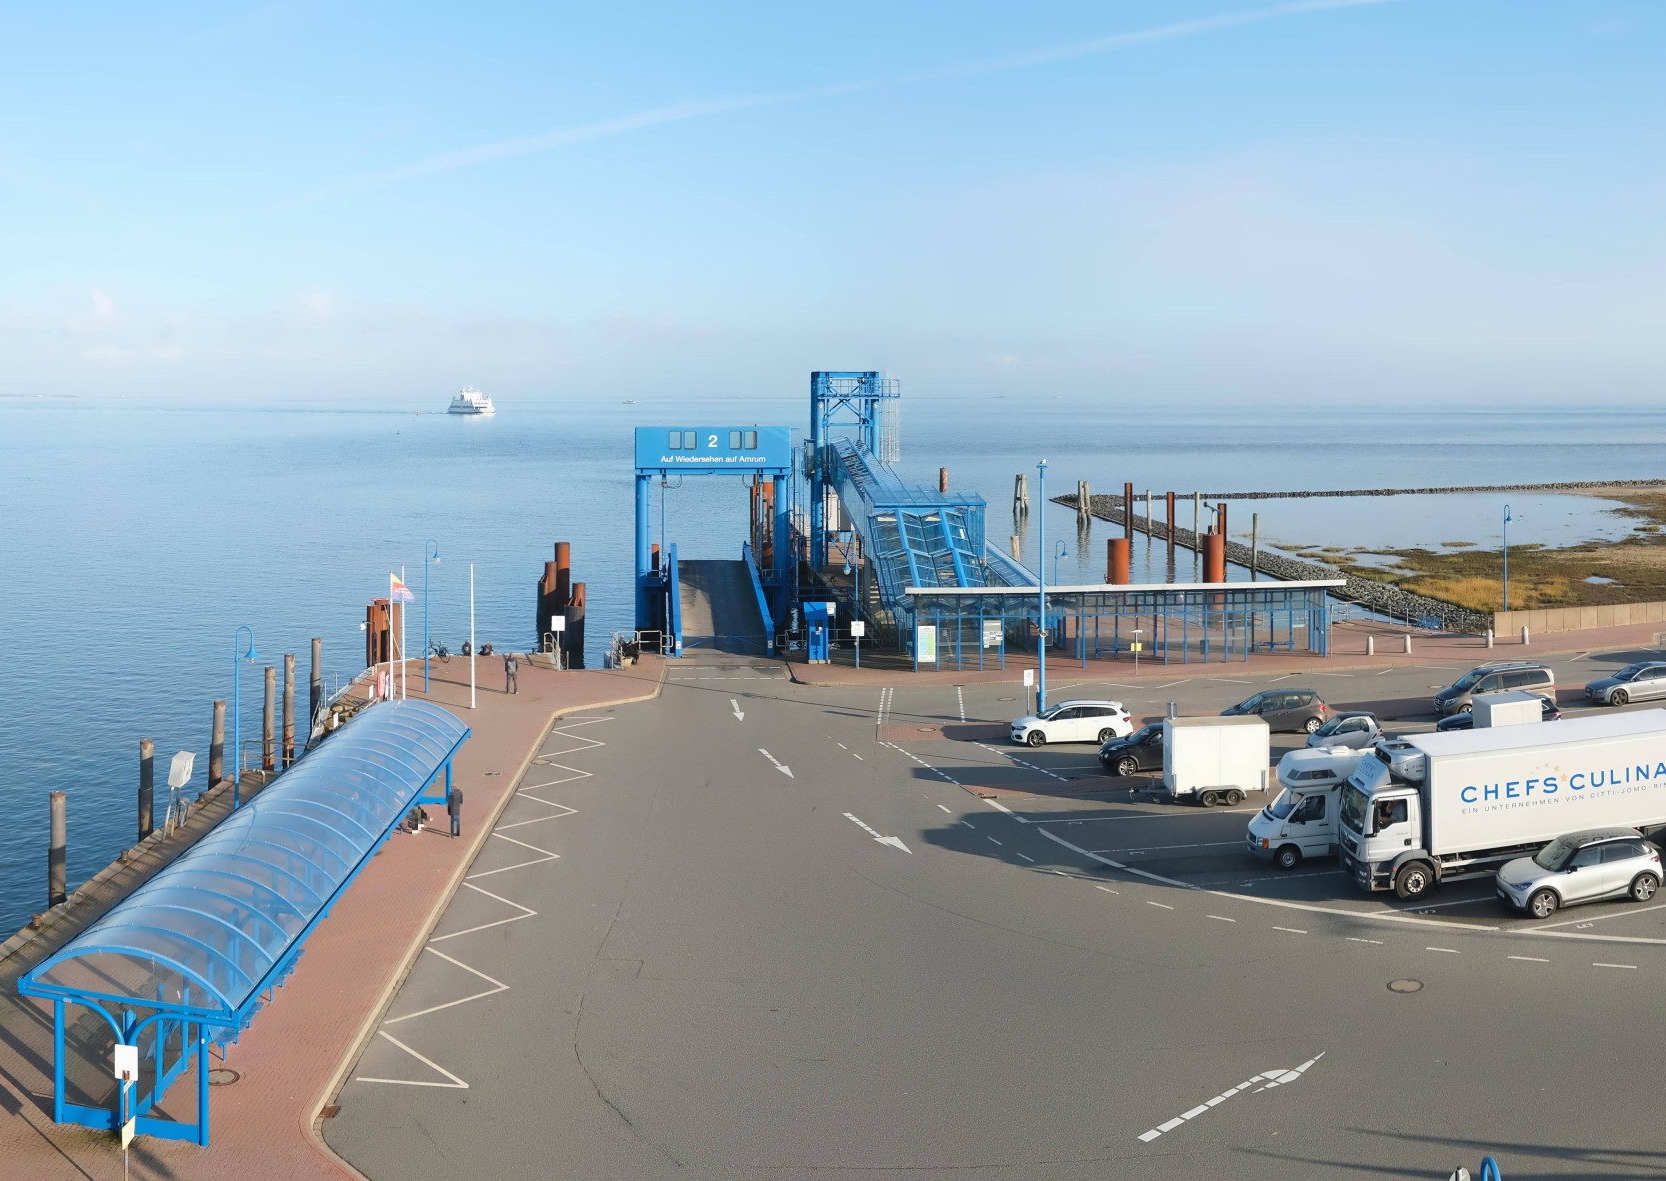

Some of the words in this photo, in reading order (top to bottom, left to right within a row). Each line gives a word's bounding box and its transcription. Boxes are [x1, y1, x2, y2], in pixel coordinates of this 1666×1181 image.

[708, 434, 718, 448] 2
[1460, 777, 1559, 804] CHEFS
[1461, 807, 1479, 815] EIN
[1484, 797, 1560, 812] UNTERNEHMEN
[1565, 794, 1585, 803] VON
